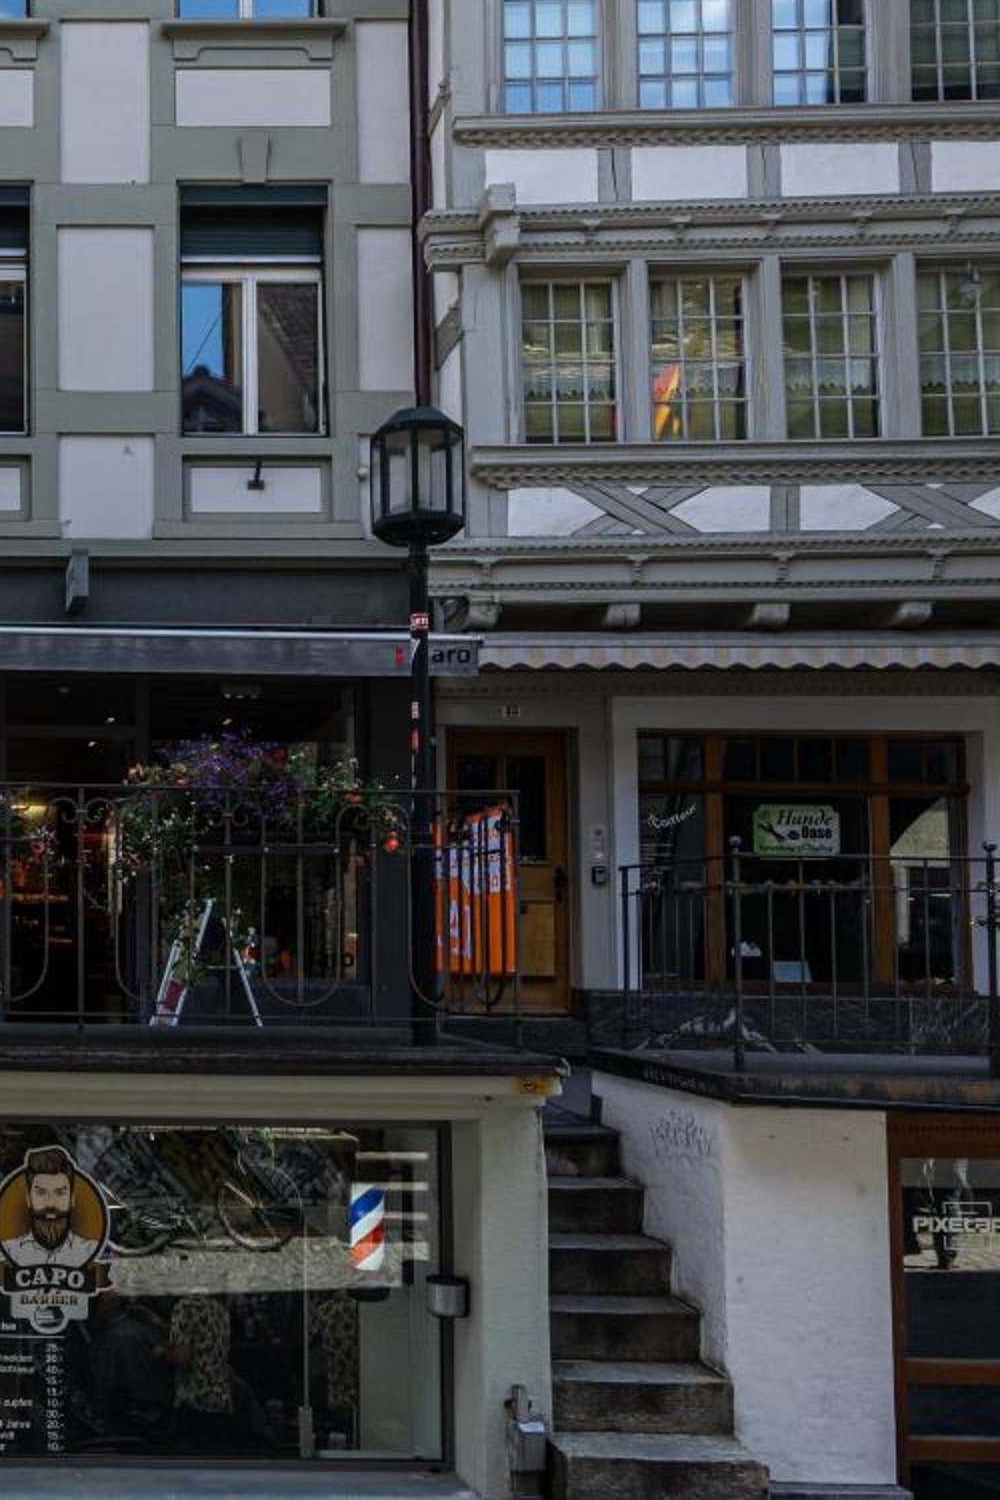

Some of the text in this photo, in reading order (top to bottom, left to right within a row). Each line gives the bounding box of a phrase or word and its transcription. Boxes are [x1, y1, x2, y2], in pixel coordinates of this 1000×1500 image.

[431, 647, 472, 664] aro
[777, 808, 832, 825] Hunde
[15, 1267, 86, 1289] CAPO
